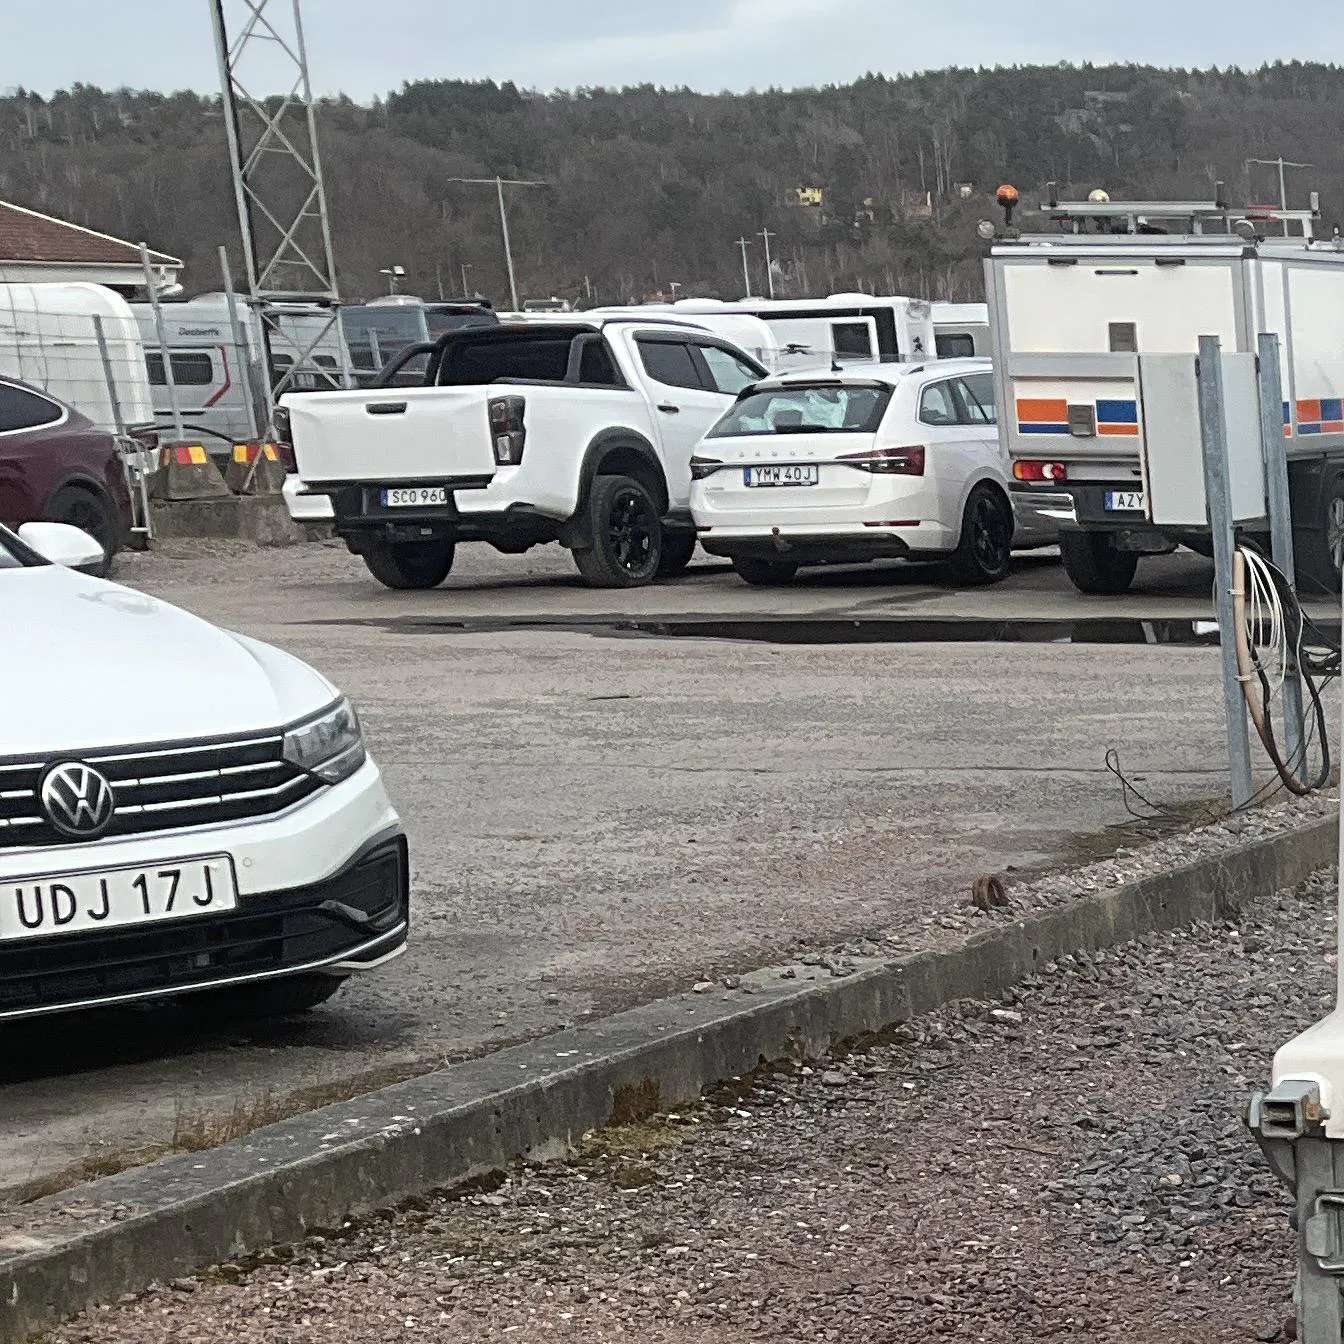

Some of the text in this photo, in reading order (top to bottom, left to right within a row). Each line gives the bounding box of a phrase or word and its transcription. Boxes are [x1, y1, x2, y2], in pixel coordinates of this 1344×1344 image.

[756, 467, 811, 481] YMW 40J
[393, 489, 446, 504] SCO 960
[1117, 493, 1145, 508] AZY
[15, 864, 214, 929] UDJ 17J
